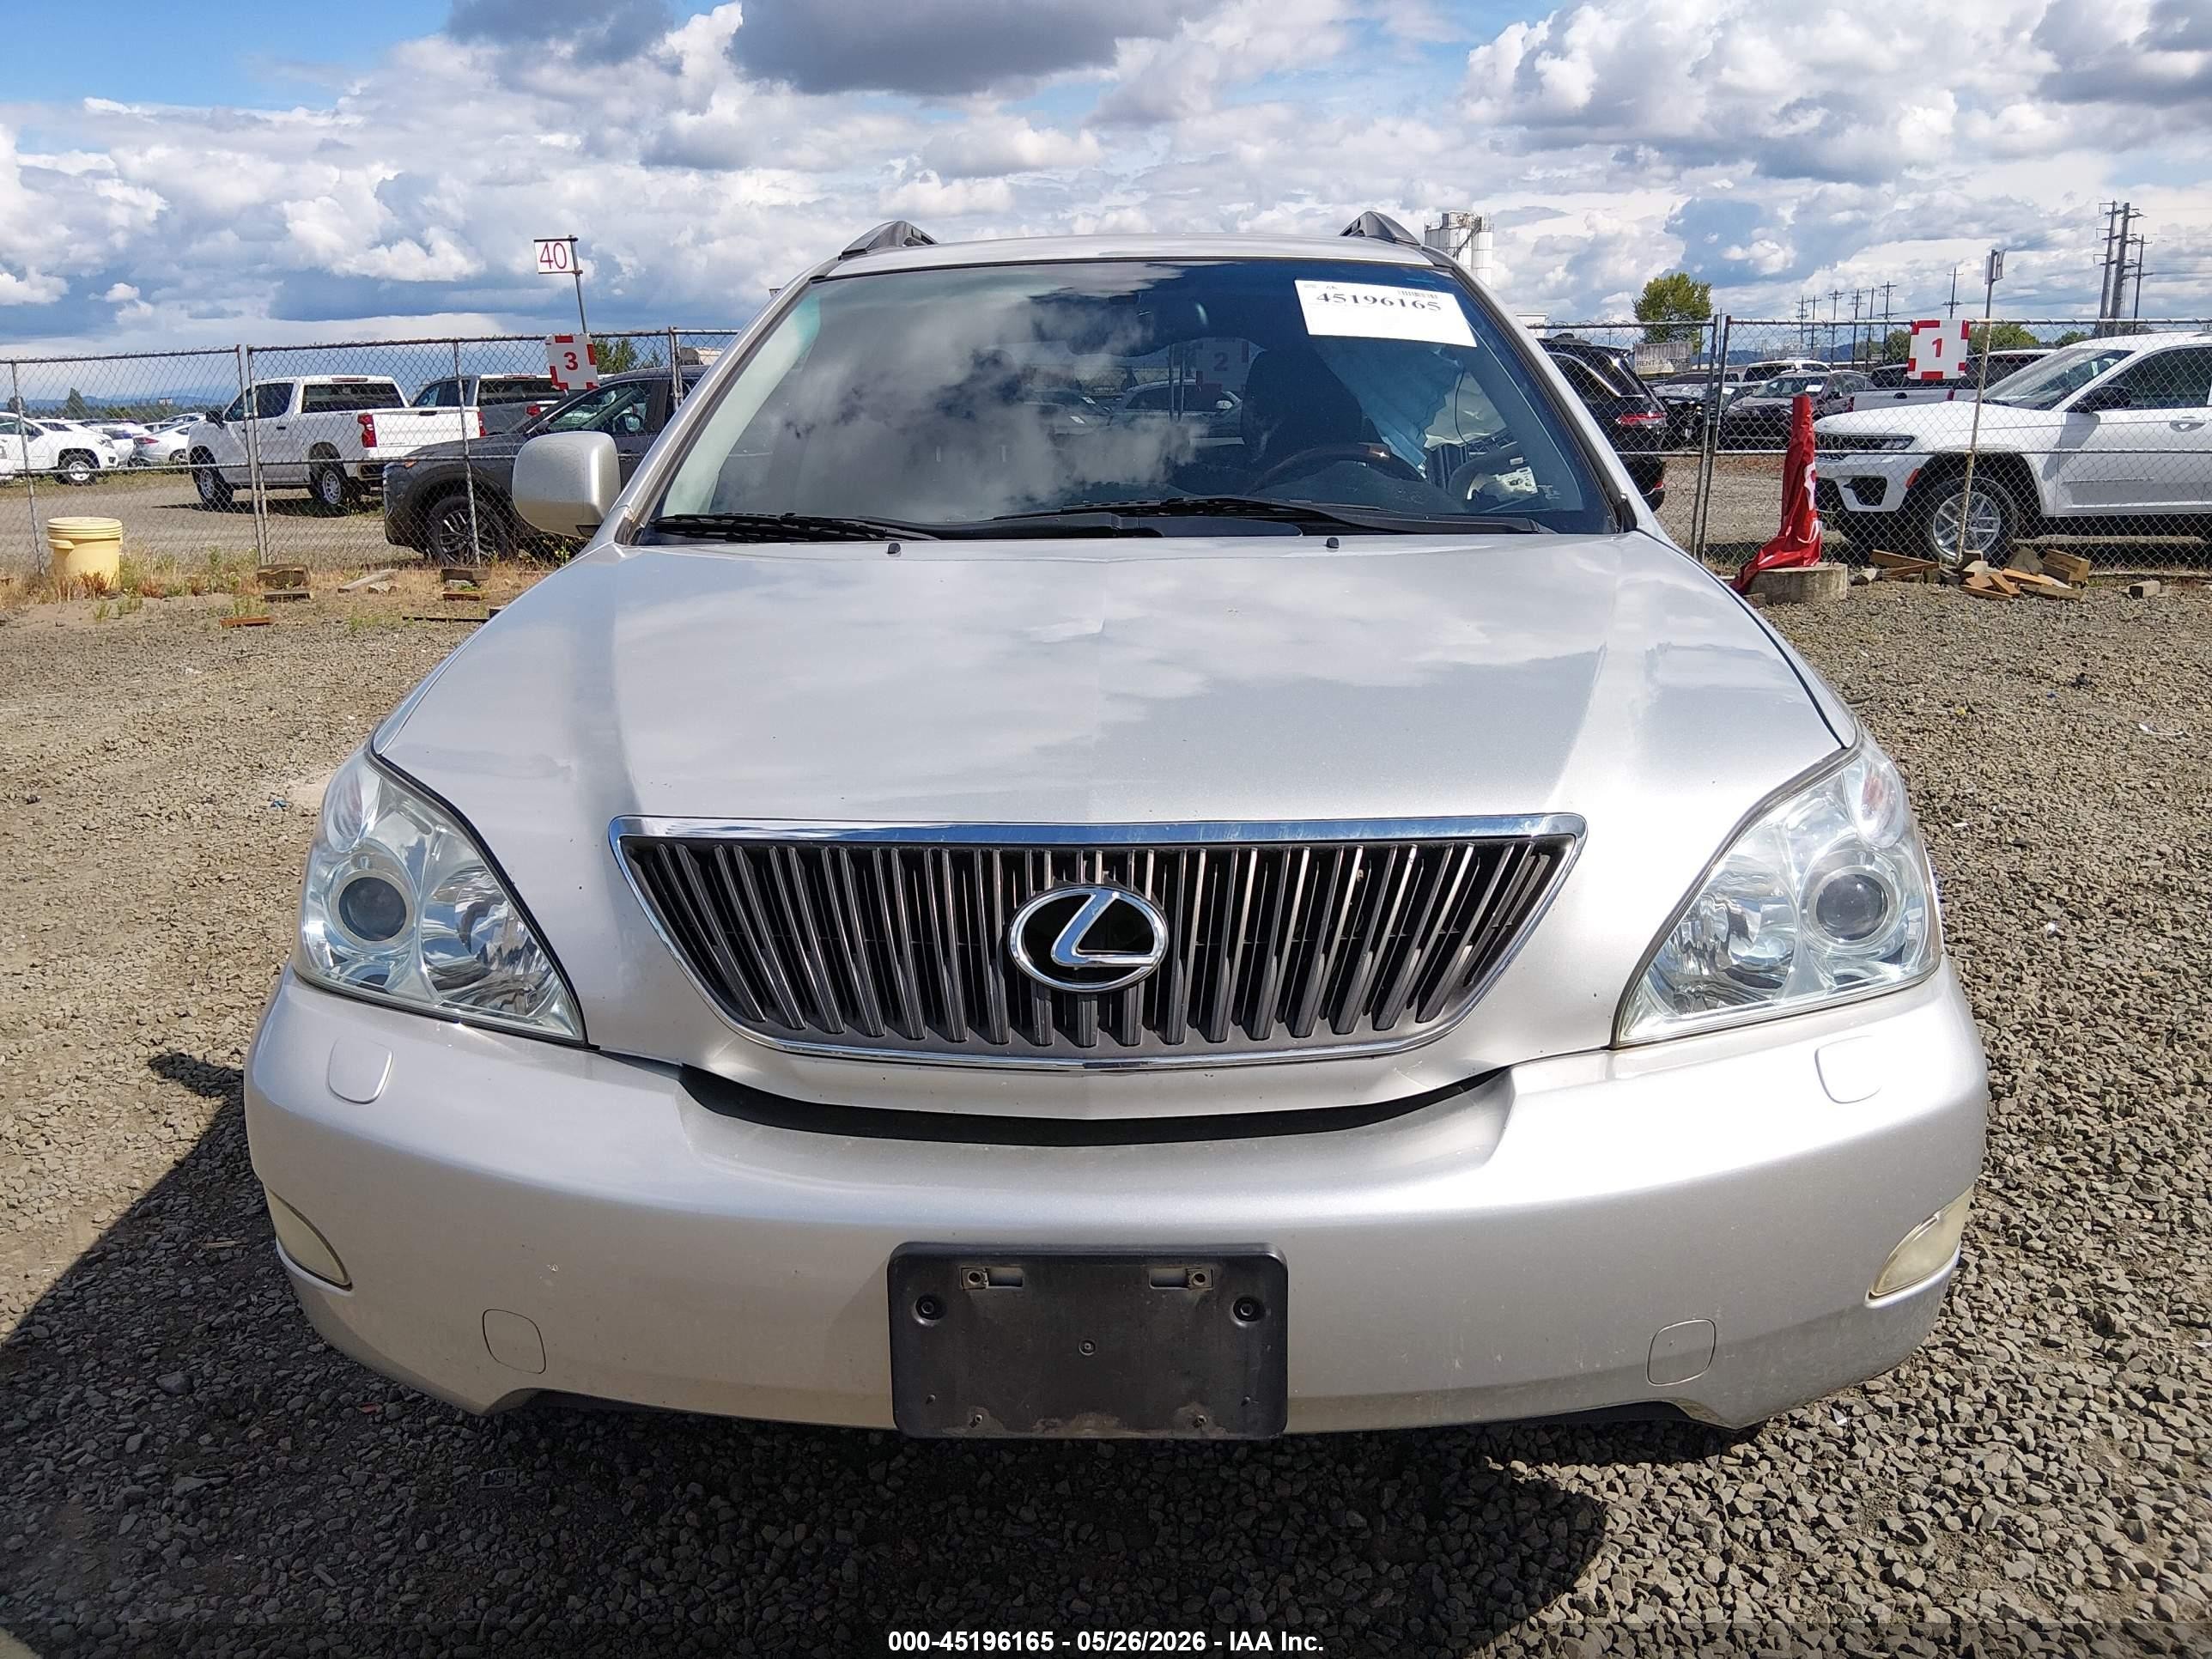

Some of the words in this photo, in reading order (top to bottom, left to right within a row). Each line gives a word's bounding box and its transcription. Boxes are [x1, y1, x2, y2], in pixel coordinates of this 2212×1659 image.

[540, 242, 567, 269] 40
[1316, 292, 1442, 312] 45196165
[1931, 337, 1942, 357] 1
[563, 351, 579, 370] 3
[1213, 351, 1228, 371] 2
